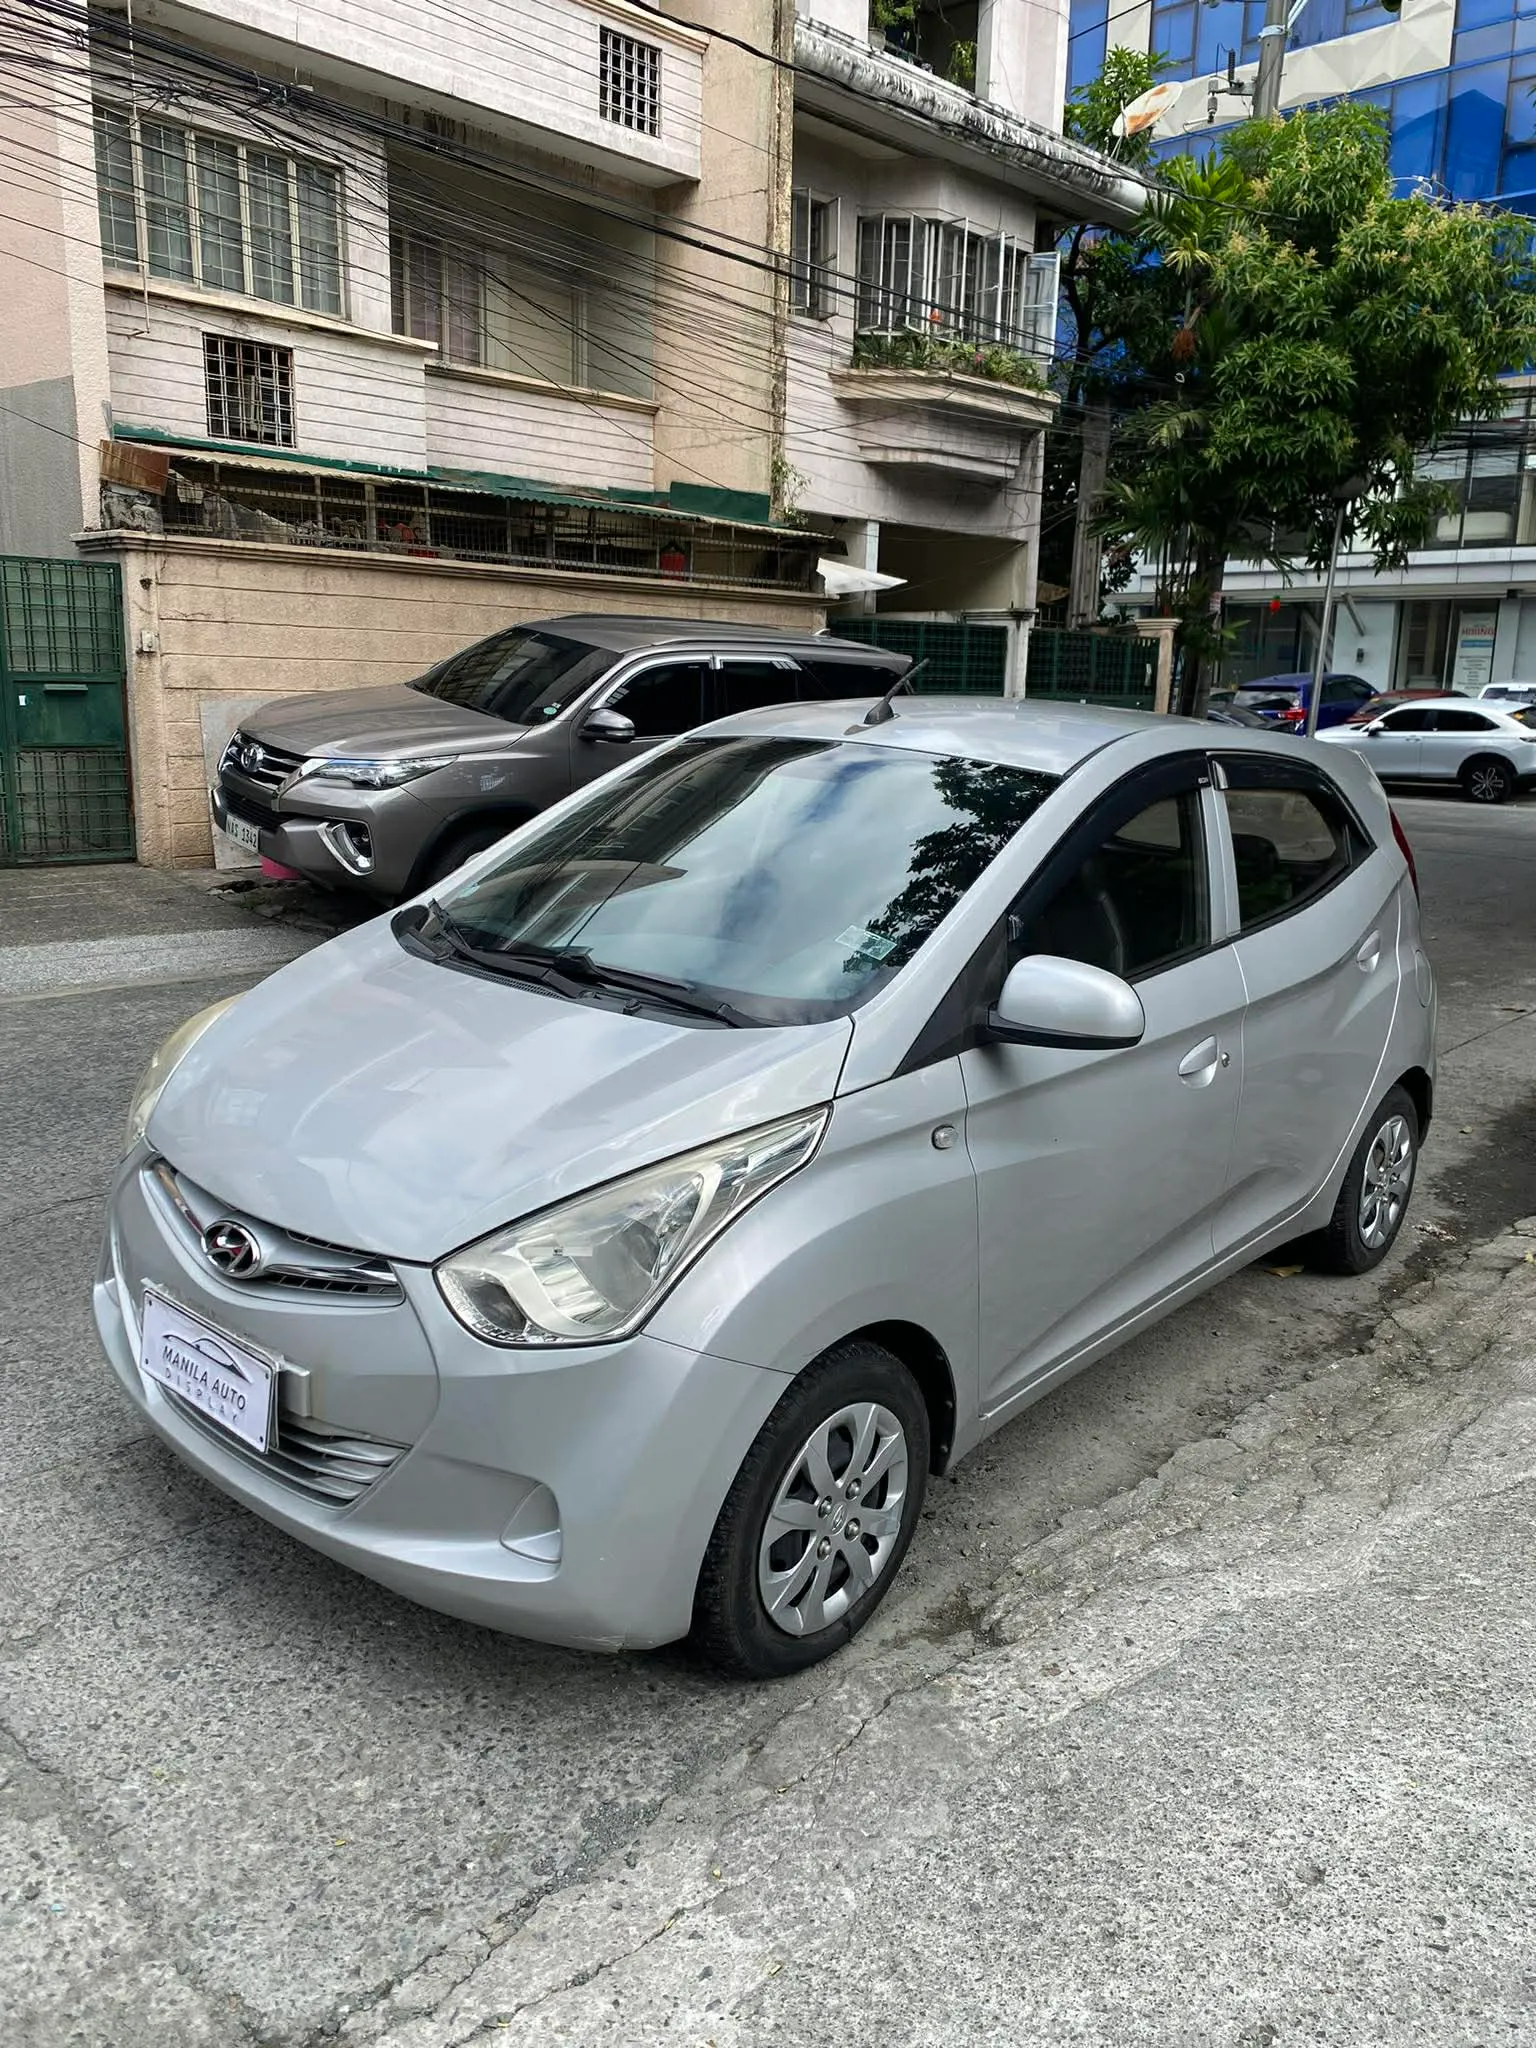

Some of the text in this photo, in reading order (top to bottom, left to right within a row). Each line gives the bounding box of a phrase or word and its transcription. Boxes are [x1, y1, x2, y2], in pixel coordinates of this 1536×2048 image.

[162, 1345, 247, 1410] MANILA AUTO
[165, 1367, 238, 1424] DISPLAY
